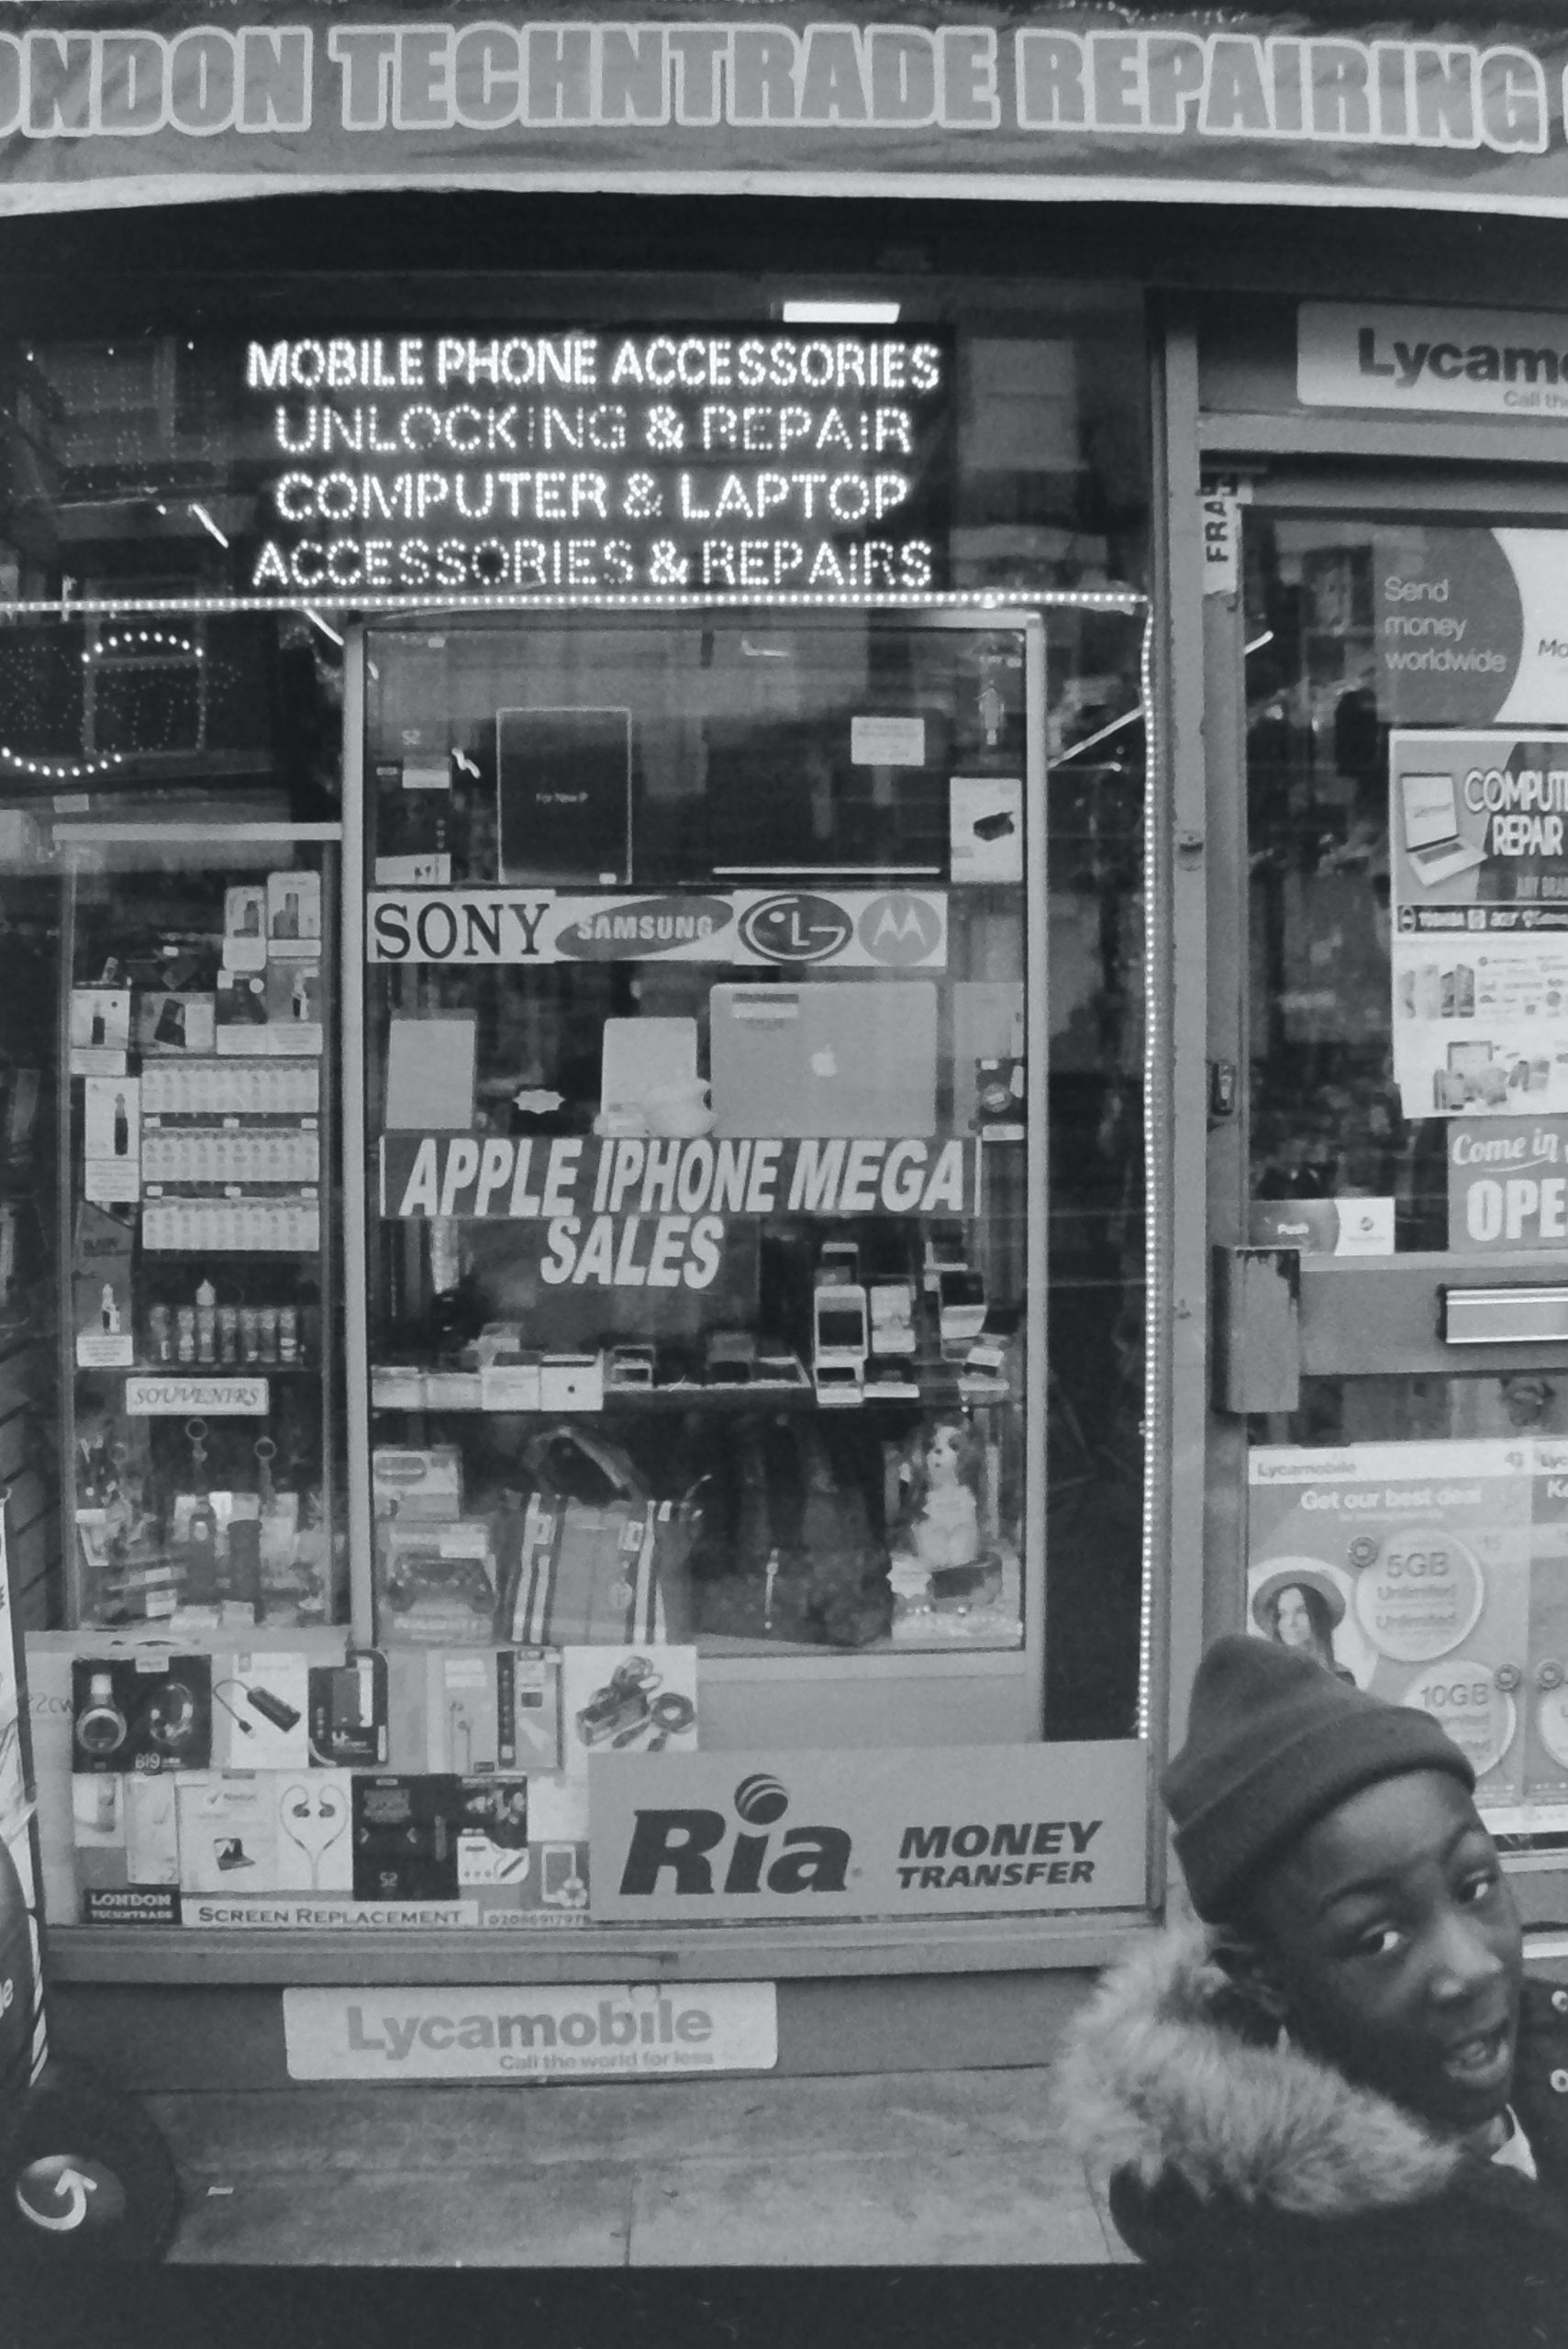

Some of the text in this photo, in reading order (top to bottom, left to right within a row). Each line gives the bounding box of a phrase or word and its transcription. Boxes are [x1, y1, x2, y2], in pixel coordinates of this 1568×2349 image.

[328, 22, 1000, 131] TECHNTRADE
[1015, 28, 1549, 154] REPAIRING
[246, 339, 942, 390] MOBILE PHONE ACCESSORIES
[1358, 328, 1568, 389] Lycam
[1504, 390, 1568, 410] Call th
[275, 406, 913, 453] UNLOCKING & REPAIR
[275, 472, 909, 521] COMPUTER & LAPTOP
[253, 540, 933, 587] ACCESSORIES & REPAIRS
[1384, 575, 1450, 603] Send
[1385, 617, 1467, 641] money
[1385, 648, 1507, 674] worldwide
[1492, 815, 1563, 857] REPAIR
[374, 902, 550, 960] SONY
[577, 915, 713, 941] SAMSUNG
[1452, 1127, 1558, 1165] Come in
[399, 1138, 965, 1217] APPLE IPHONE MEGA
[1467, 1178, 1568, 1241] OPE
[540, 1215, 726, 1290] SALES
[133, 1386, 261, 1406] SOUVENIRS
[1300, 1490, 1340, 1510] Get
[1344, 1493, 1379, 1509] our
[1386, 1487, 1432, 1508] best
[1386, 1552, 1450, 1579] 5GB
[1421, 1682, 1489, 1709] 10GB
[618, 1772, 852, 1896] Ria
[897, 1820, 1103, 1859] MONEY
[895, 1860, 1095, 1889] TRANSFER
[91, 1893, 172, 1907] LONDON
[198, 1906, 461, 1925] SCREEN REPLACEMENT
[346, 1998, 716, 2062] Lycamobile
[499, 2048, 715, 2071] Call the world for less
